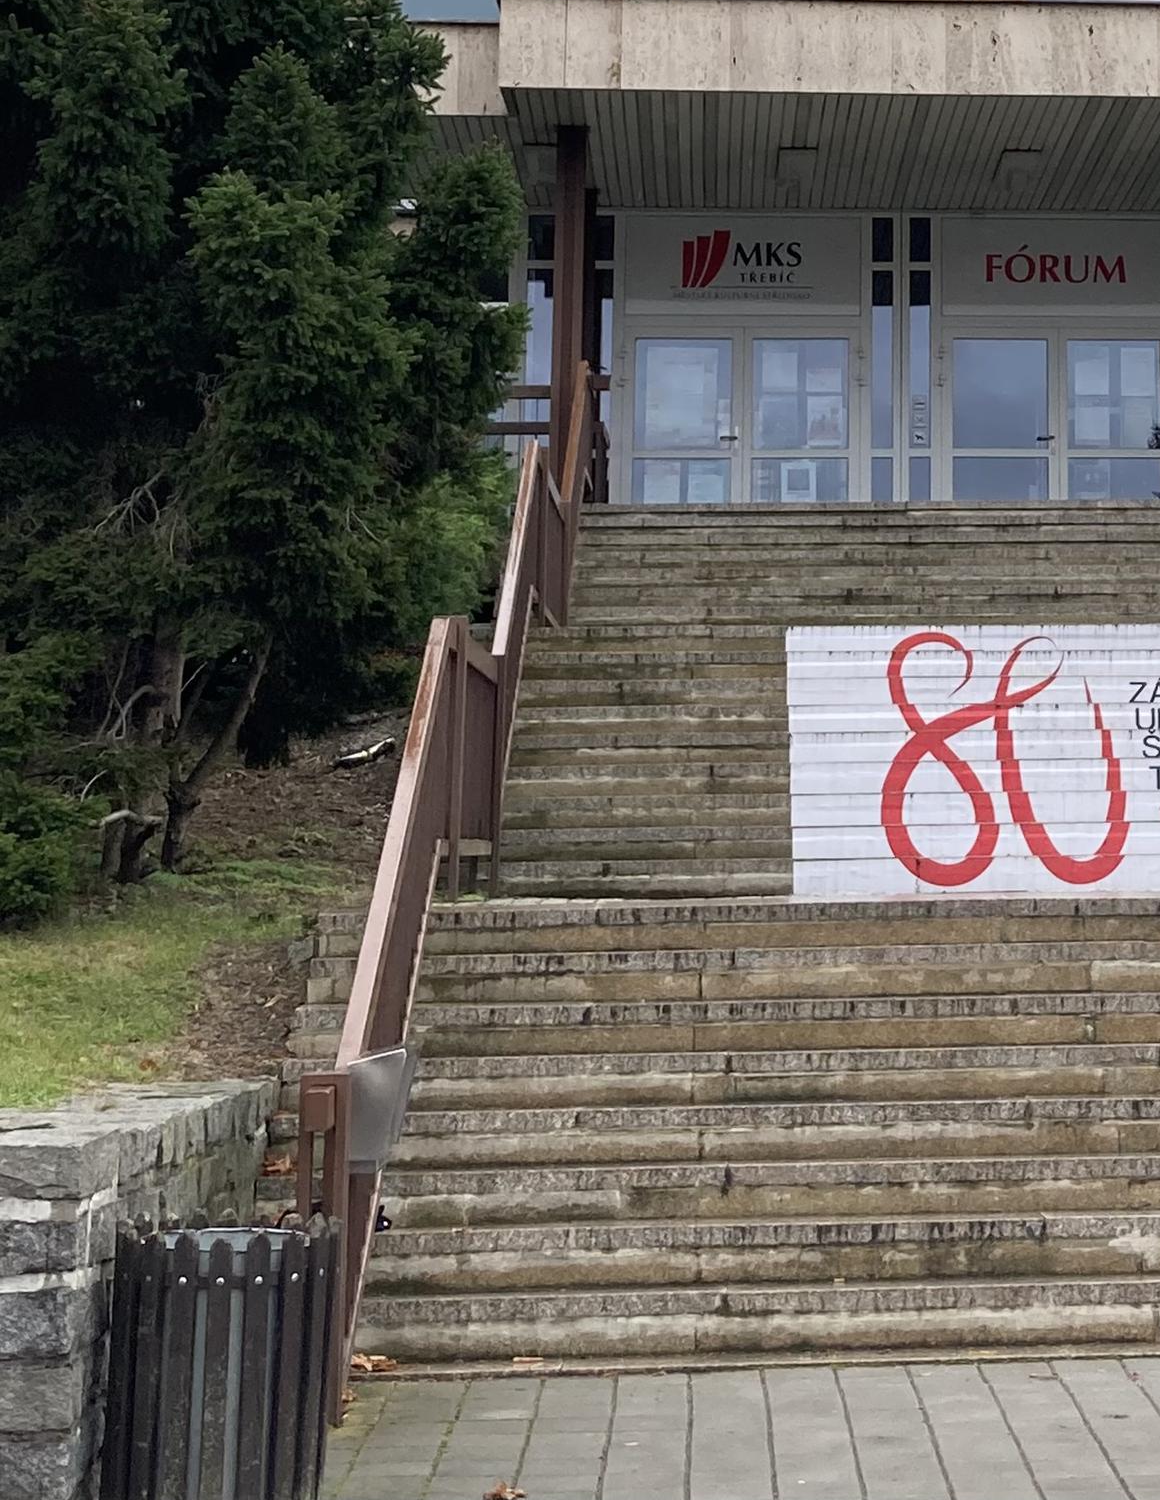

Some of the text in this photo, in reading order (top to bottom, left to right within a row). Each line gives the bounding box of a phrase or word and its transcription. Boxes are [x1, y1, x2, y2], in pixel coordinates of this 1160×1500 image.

[733, 242, 802, 267] MKS
[985, 244, 1126, 283] FÓRUM
[740, 271, 796, 283] TŘEBÍČ
[881, 631, 1130, 886] 80
